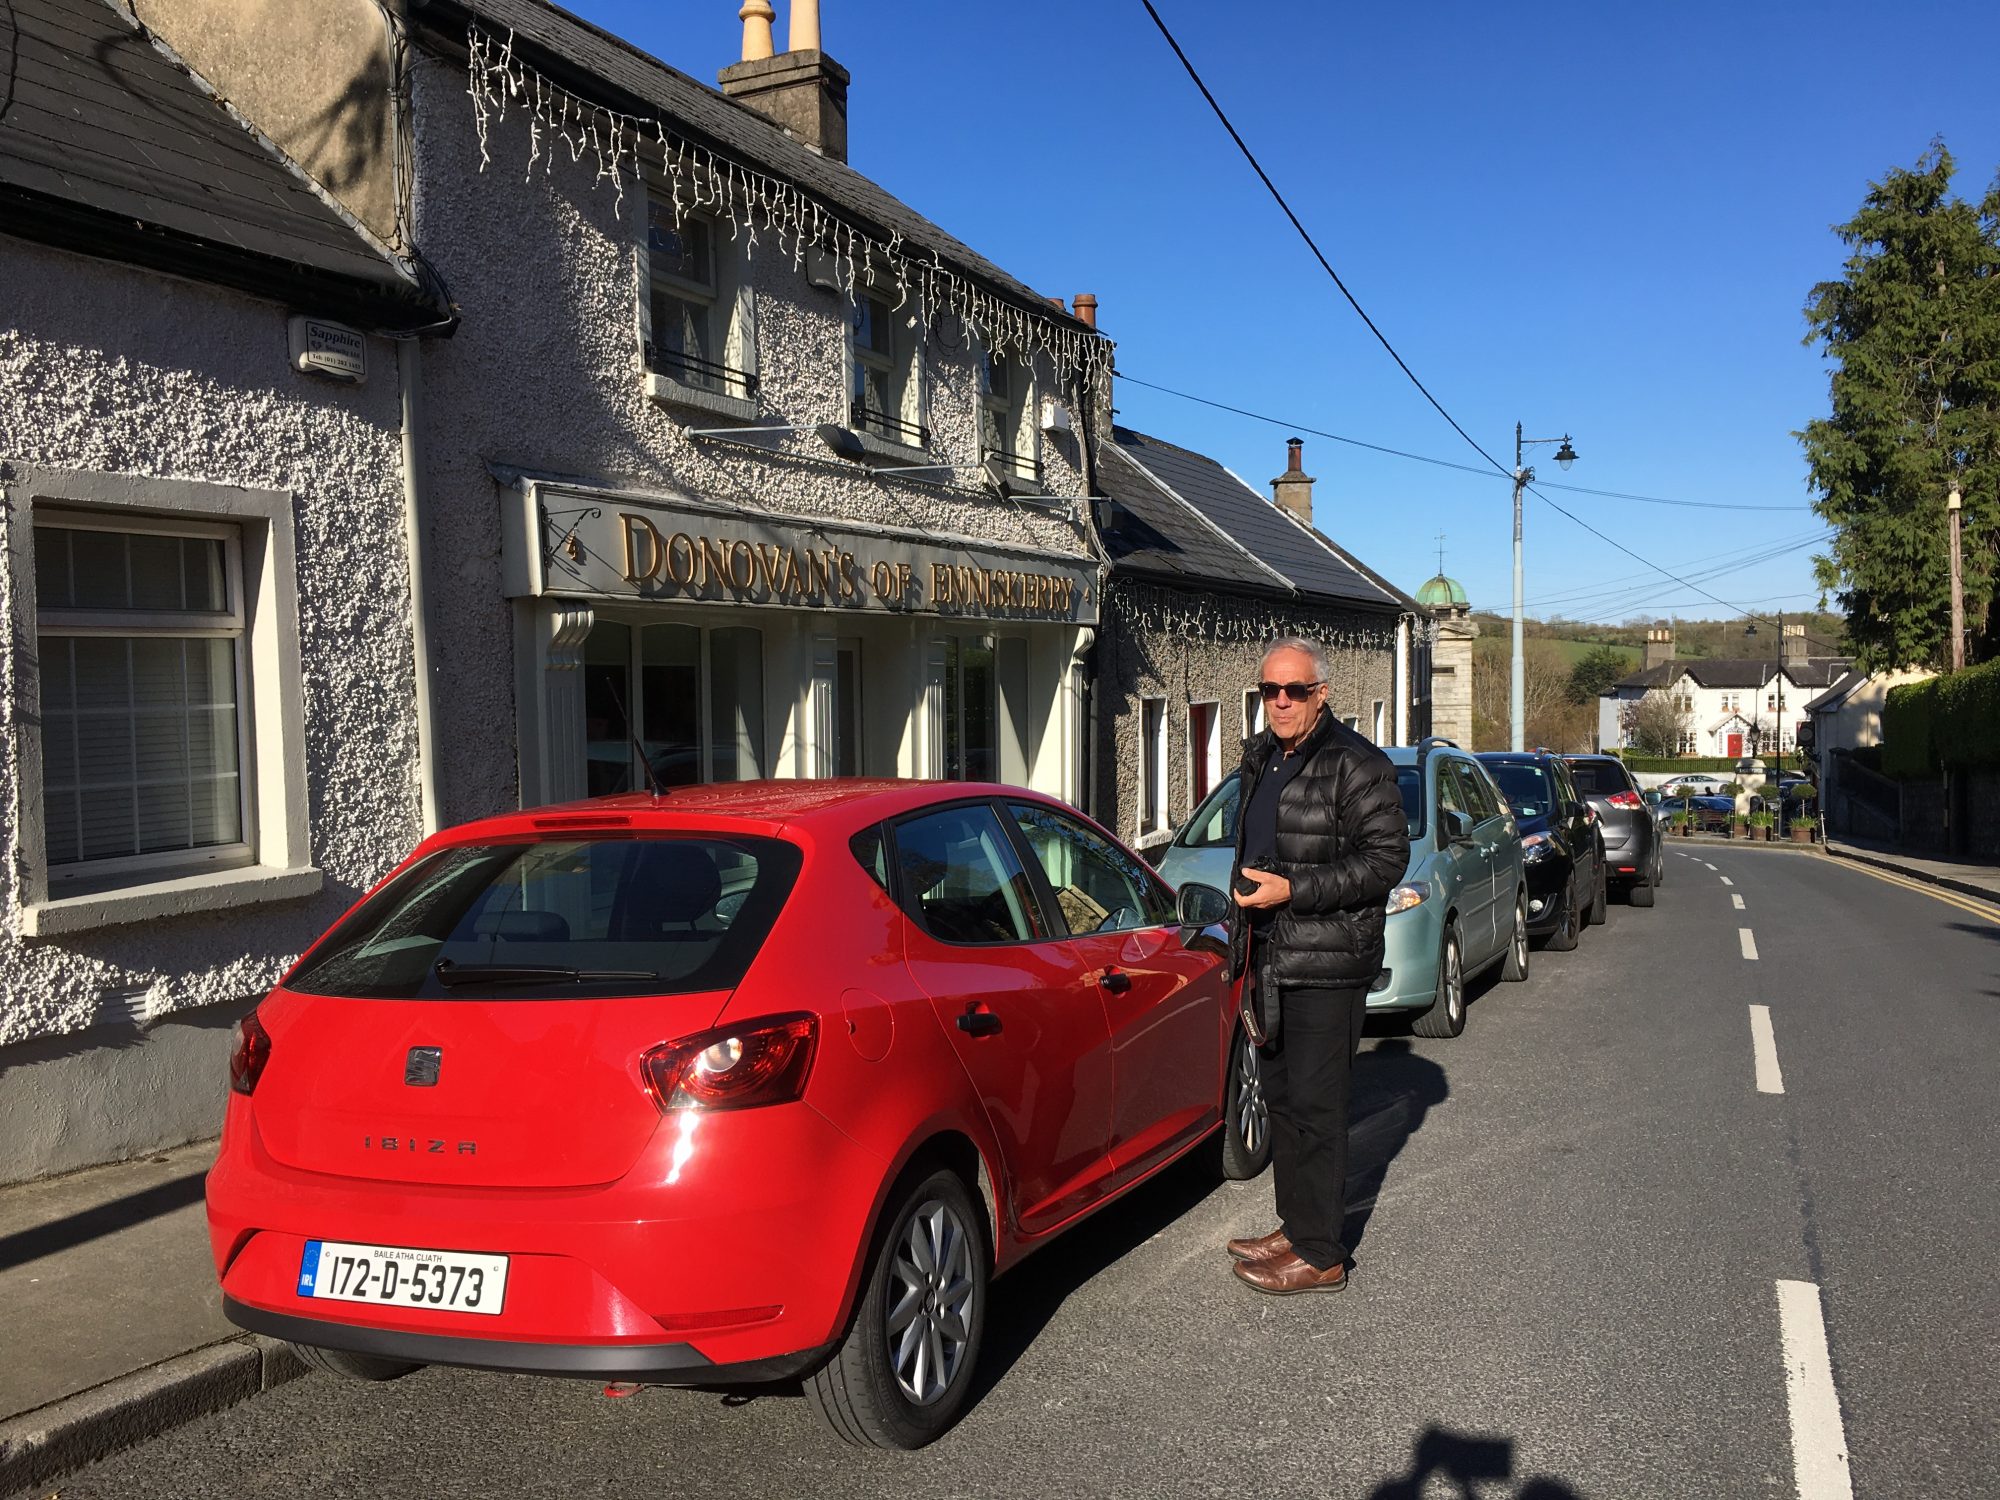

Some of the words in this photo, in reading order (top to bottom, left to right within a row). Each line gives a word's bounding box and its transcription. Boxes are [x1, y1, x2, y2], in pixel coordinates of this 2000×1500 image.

[310, 326, 361, 349] Sapphire
[872, 560, 912, 601] OF
[930, 562, 1075, 612] ENNISKERRY
[1243, 1010, 1257, 1037] Canon
[365, 1136, 477, 1155] IBIZA
[374, 1250, 394, 1259] BAILE
[416, 1253, 443, 1263] CLIATH
[301, 1274, 314, 1287] IRL
[330, 1256, 484, 1308] 172-D-5373
